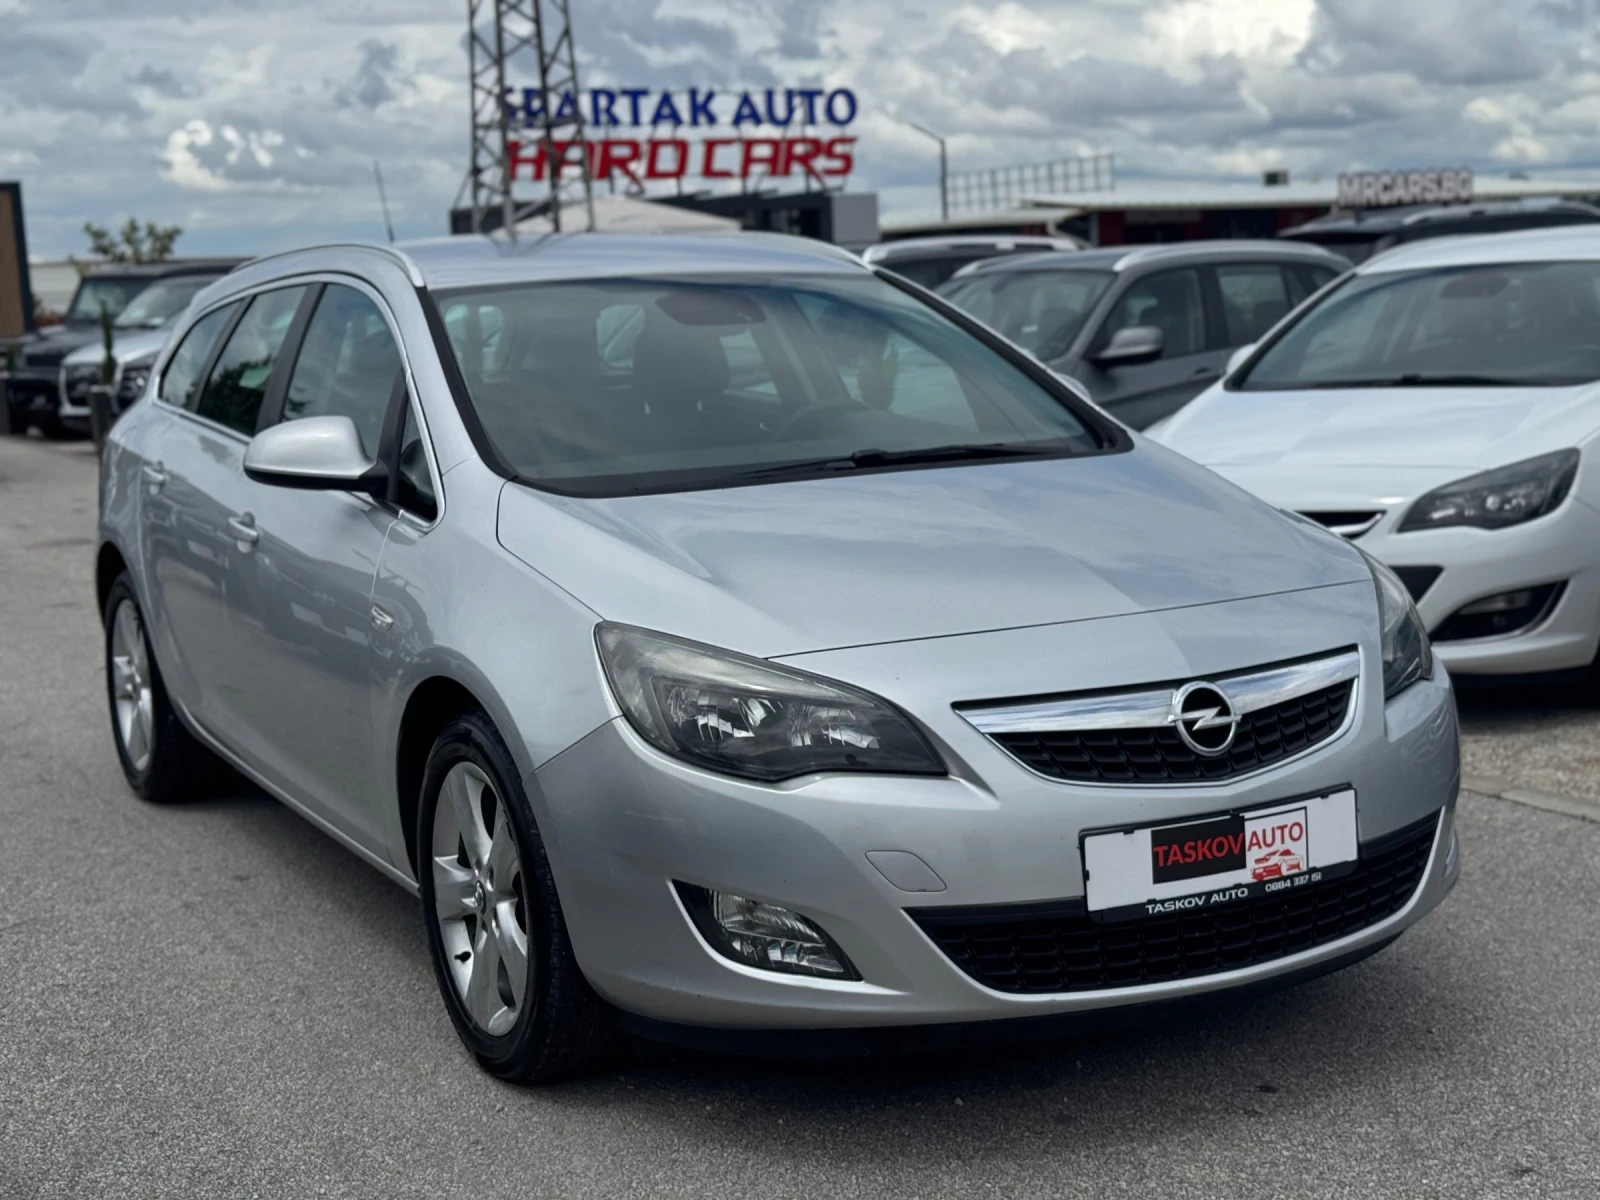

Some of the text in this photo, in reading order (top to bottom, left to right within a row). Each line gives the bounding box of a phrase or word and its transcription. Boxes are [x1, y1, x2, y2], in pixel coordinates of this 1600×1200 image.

[732, 87, 859, 127] AUTO
[506, 136, 859, 193] HARD CARS
[1153, 821, 1304, 868] TASKOV AUTO
[1145, 895, 1207, 915] TASKOV
[1210, 887, 1249, 904] AUTO
[1264, 879, 1292, 893] 0884
